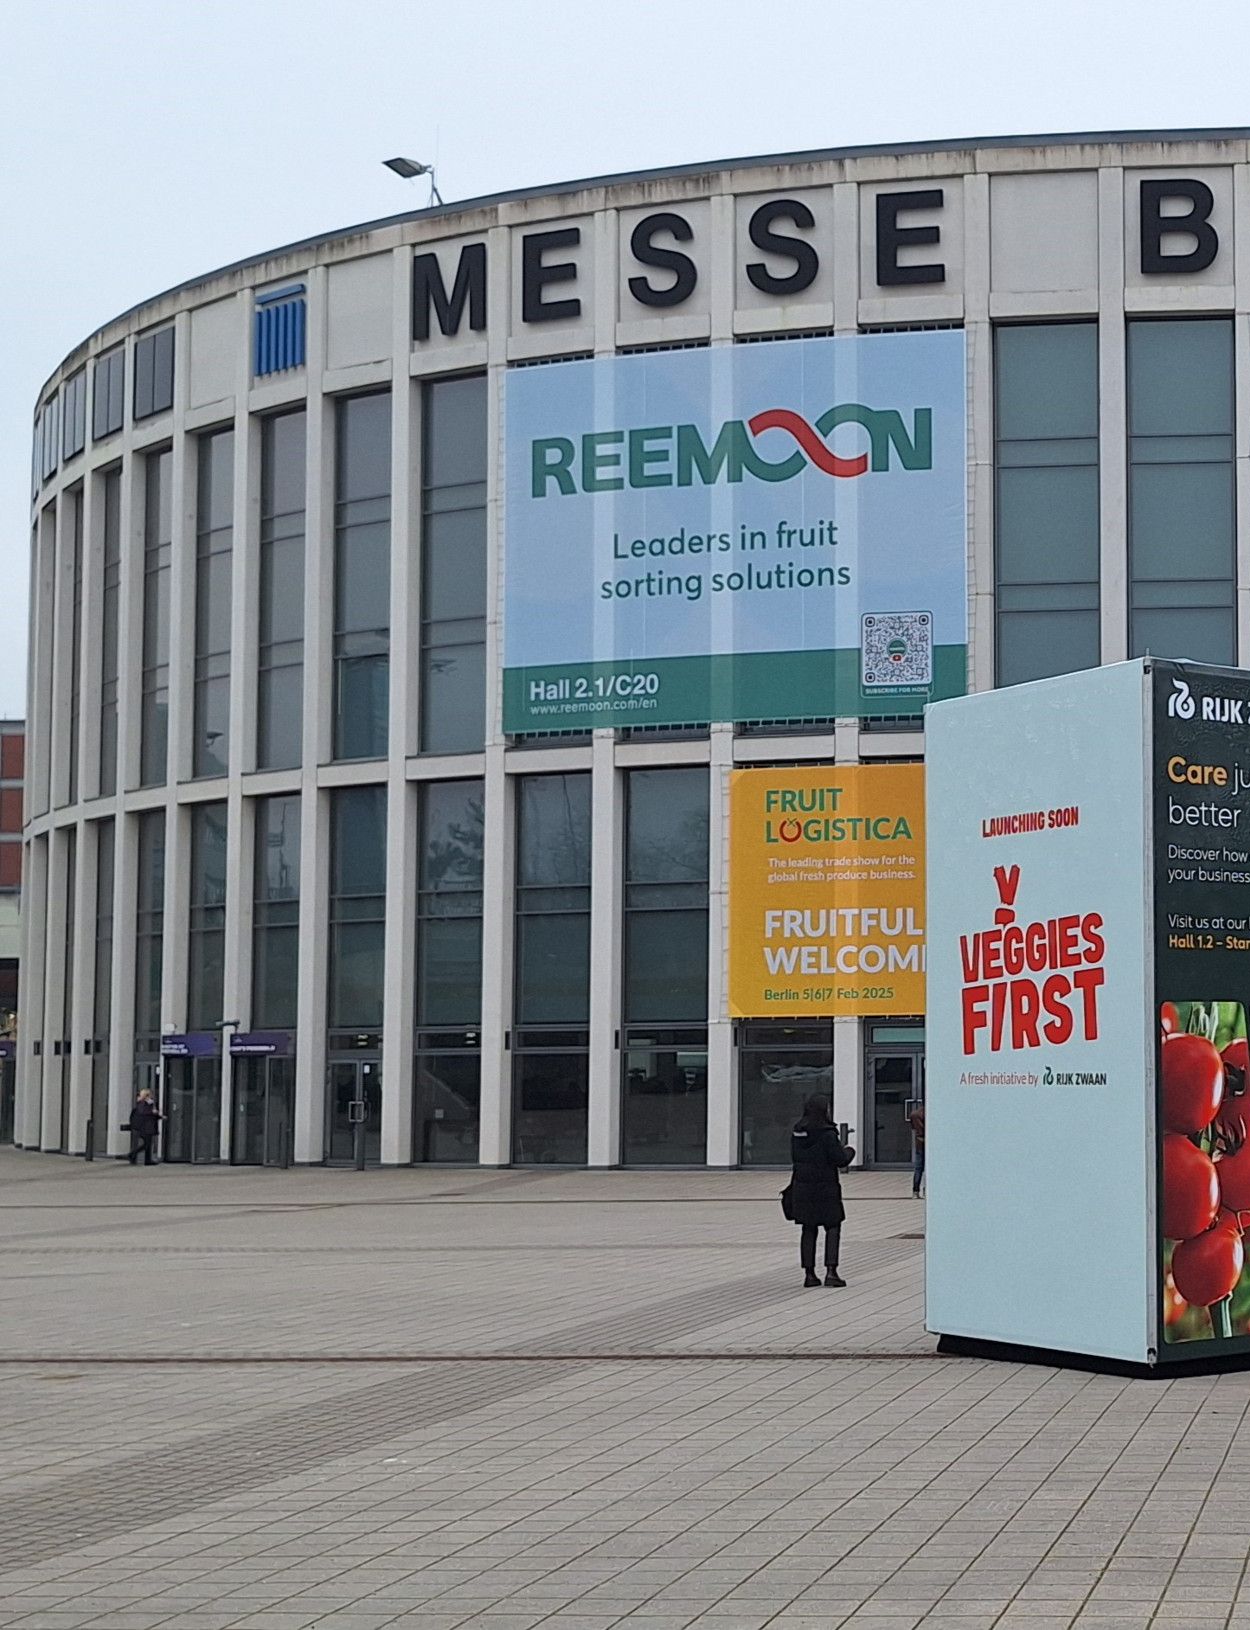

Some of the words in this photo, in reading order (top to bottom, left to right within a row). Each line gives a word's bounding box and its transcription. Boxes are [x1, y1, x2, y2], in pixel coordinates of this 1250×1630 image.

[413, 189, 945, 340] MESSE
[531, 403, 932, 499] REEMOON
[613, 528, 730, 559] Leaders
[740, 525, 766, 550] in
[776, 520, 838, 548] fruit
[601, 571, 702, 600] sorting
[712, 563, 850, 592] solutions
[530, 679, 570, 701] Hall
[574, 673, 659, 698] 2.1/C20
[530, 698, 657, 715] www.reemoon.com/en
[1202, 696, 1243, 725] RIJK
[1167, 755, 1227, 786] Care
[765, 788, 843, 813] FRUIT
[1169, 796, 1241, 827] better
[982, 811, 1045, 838] LAUNCHING
[1047, 806, 1079, 828] SOON
[768, 857, 786, 868] The
[788, 857, 823, 869] leading
[825, 856, 851, 868] trade
[853, 856, 880, 867] show
[881, 855, 896, 866] for
[899, 854, 915, 865] the
[1168, 844, 1220, 862] Discover
[1223, 847, 1248, 863] how
[768, 871, 798, 884] global
[800, 871, 825, 882] fresh
[827, 870, 868, 883] produce
[870, 869, 916, 880] business.
[1168, 869, 1196, 883] your
[1198, 867, 1250, 883] business
[765, 907, 923, 938] FRUITFUL
[1168, 914, 1193, 928] Visit
[1195, 918, 1209, 929] us
[1211, 917, 1224, 929] at
[1226, 918, 1246, 930] our
[960, 912, 1105, 984] VEGGIES
[1168, 934, 1195, 948] Hall
[1197, 936, 1213, 949] 1.2
[764, 989, 799, 1000] Berlin
[837, 987, 859, 999] Feb
[862, 987, 894, 999] 2025
[961, 967, 1105, 1055] FIRST
[960, 1073, 967, 1084] A
[968, 1072, 989, 1085] fresh
[990, 1072, 1026, 1085] initiative
[1027, 1073, 1038, 1088] by
[1056, 1074, 1074, 1085] RIJK
[1075, 1072, 1106, 1086] ZWAAN
